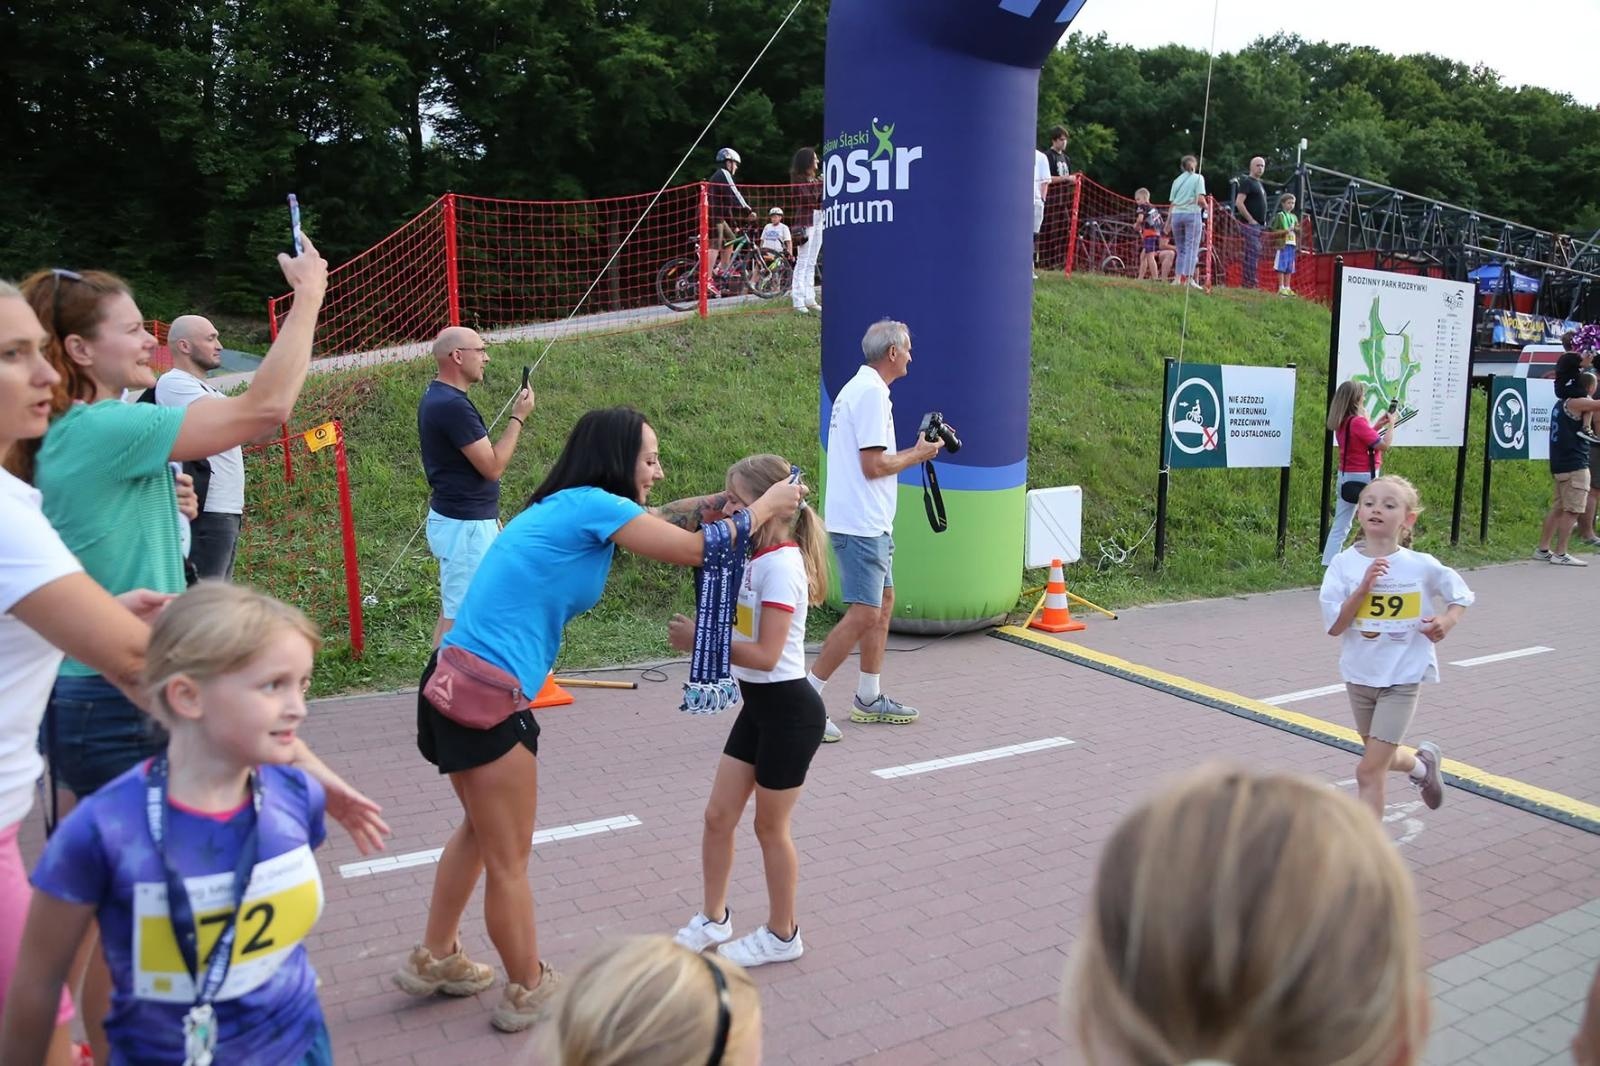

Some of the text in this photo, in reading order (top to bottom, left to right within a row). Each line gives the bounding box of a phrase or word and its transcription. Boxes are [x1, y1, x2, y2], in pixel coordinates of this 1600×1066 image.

[839, 130, 869, 149] Śląski
[823, 146, 922, 200] osir
[1347, 275, 1428, 292] RODZINNY PARK ROZRYWKI
[1229, 396, 1239, 404] NIE
[1236, 407, 1267, 415] KIERUNKU
[1370, 595, 1404, 617] 59
[696, 628, 704, 649] NOCNY
[200, 903, 275, 964] 72
